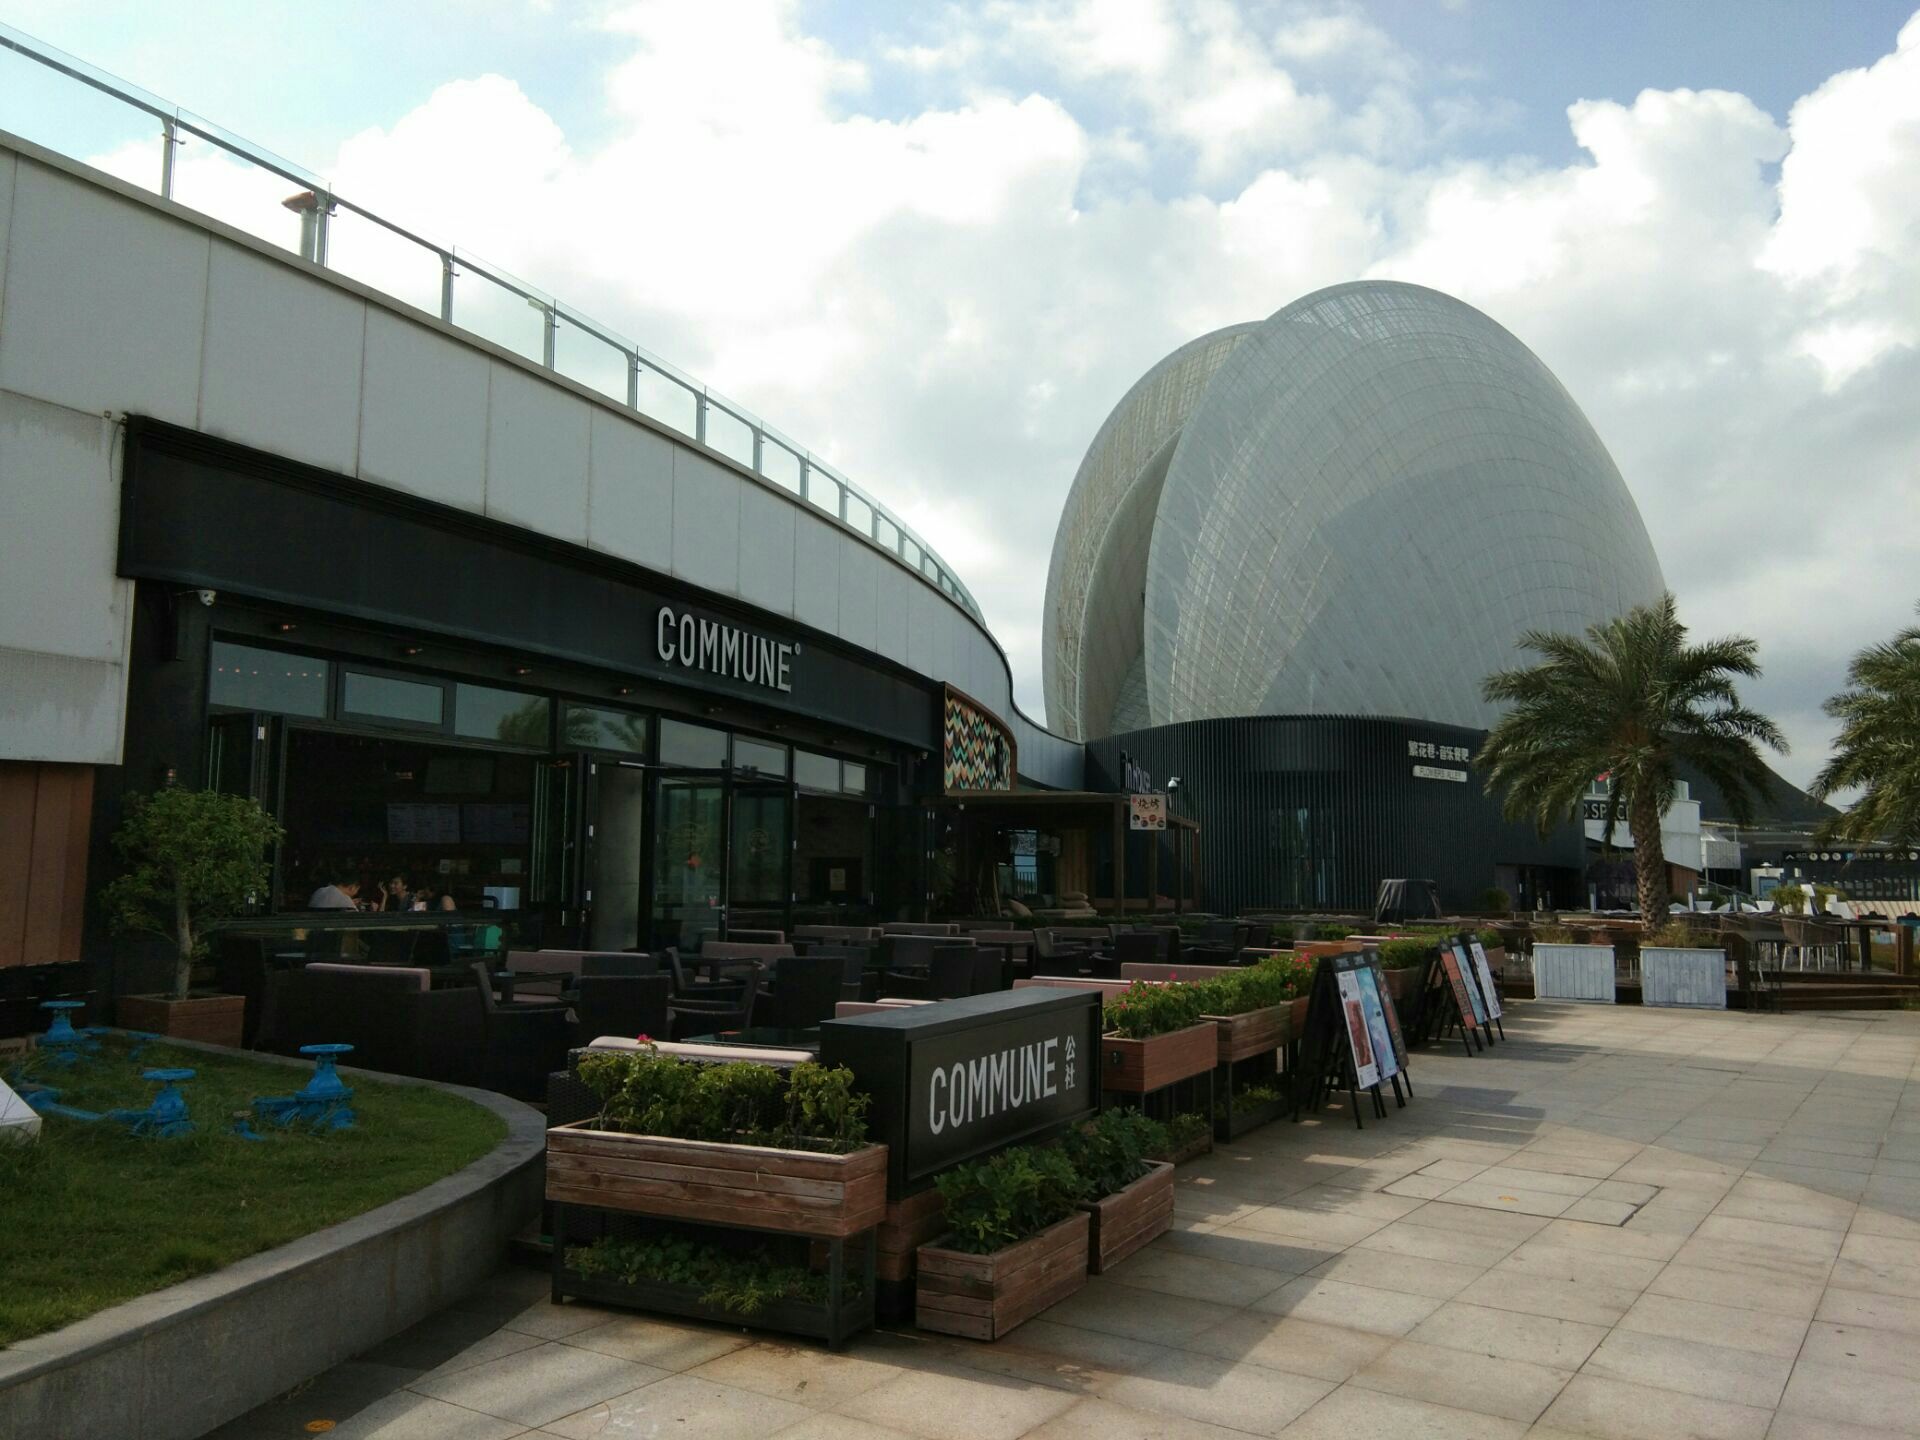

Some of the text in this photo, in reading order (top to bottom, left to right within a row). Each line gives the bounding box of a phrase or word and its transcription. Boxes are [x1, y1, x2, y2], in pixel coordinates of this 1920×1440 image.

[658, 606, 793, 693] COMMUNE
[1137, 798, 1160, 810] 烧烤
[1591, 803, 1630, 820] SPC
[929, 1036, 1058, 1135] COMMUNE
[1065, 1035, 1076, 1090] 公社
